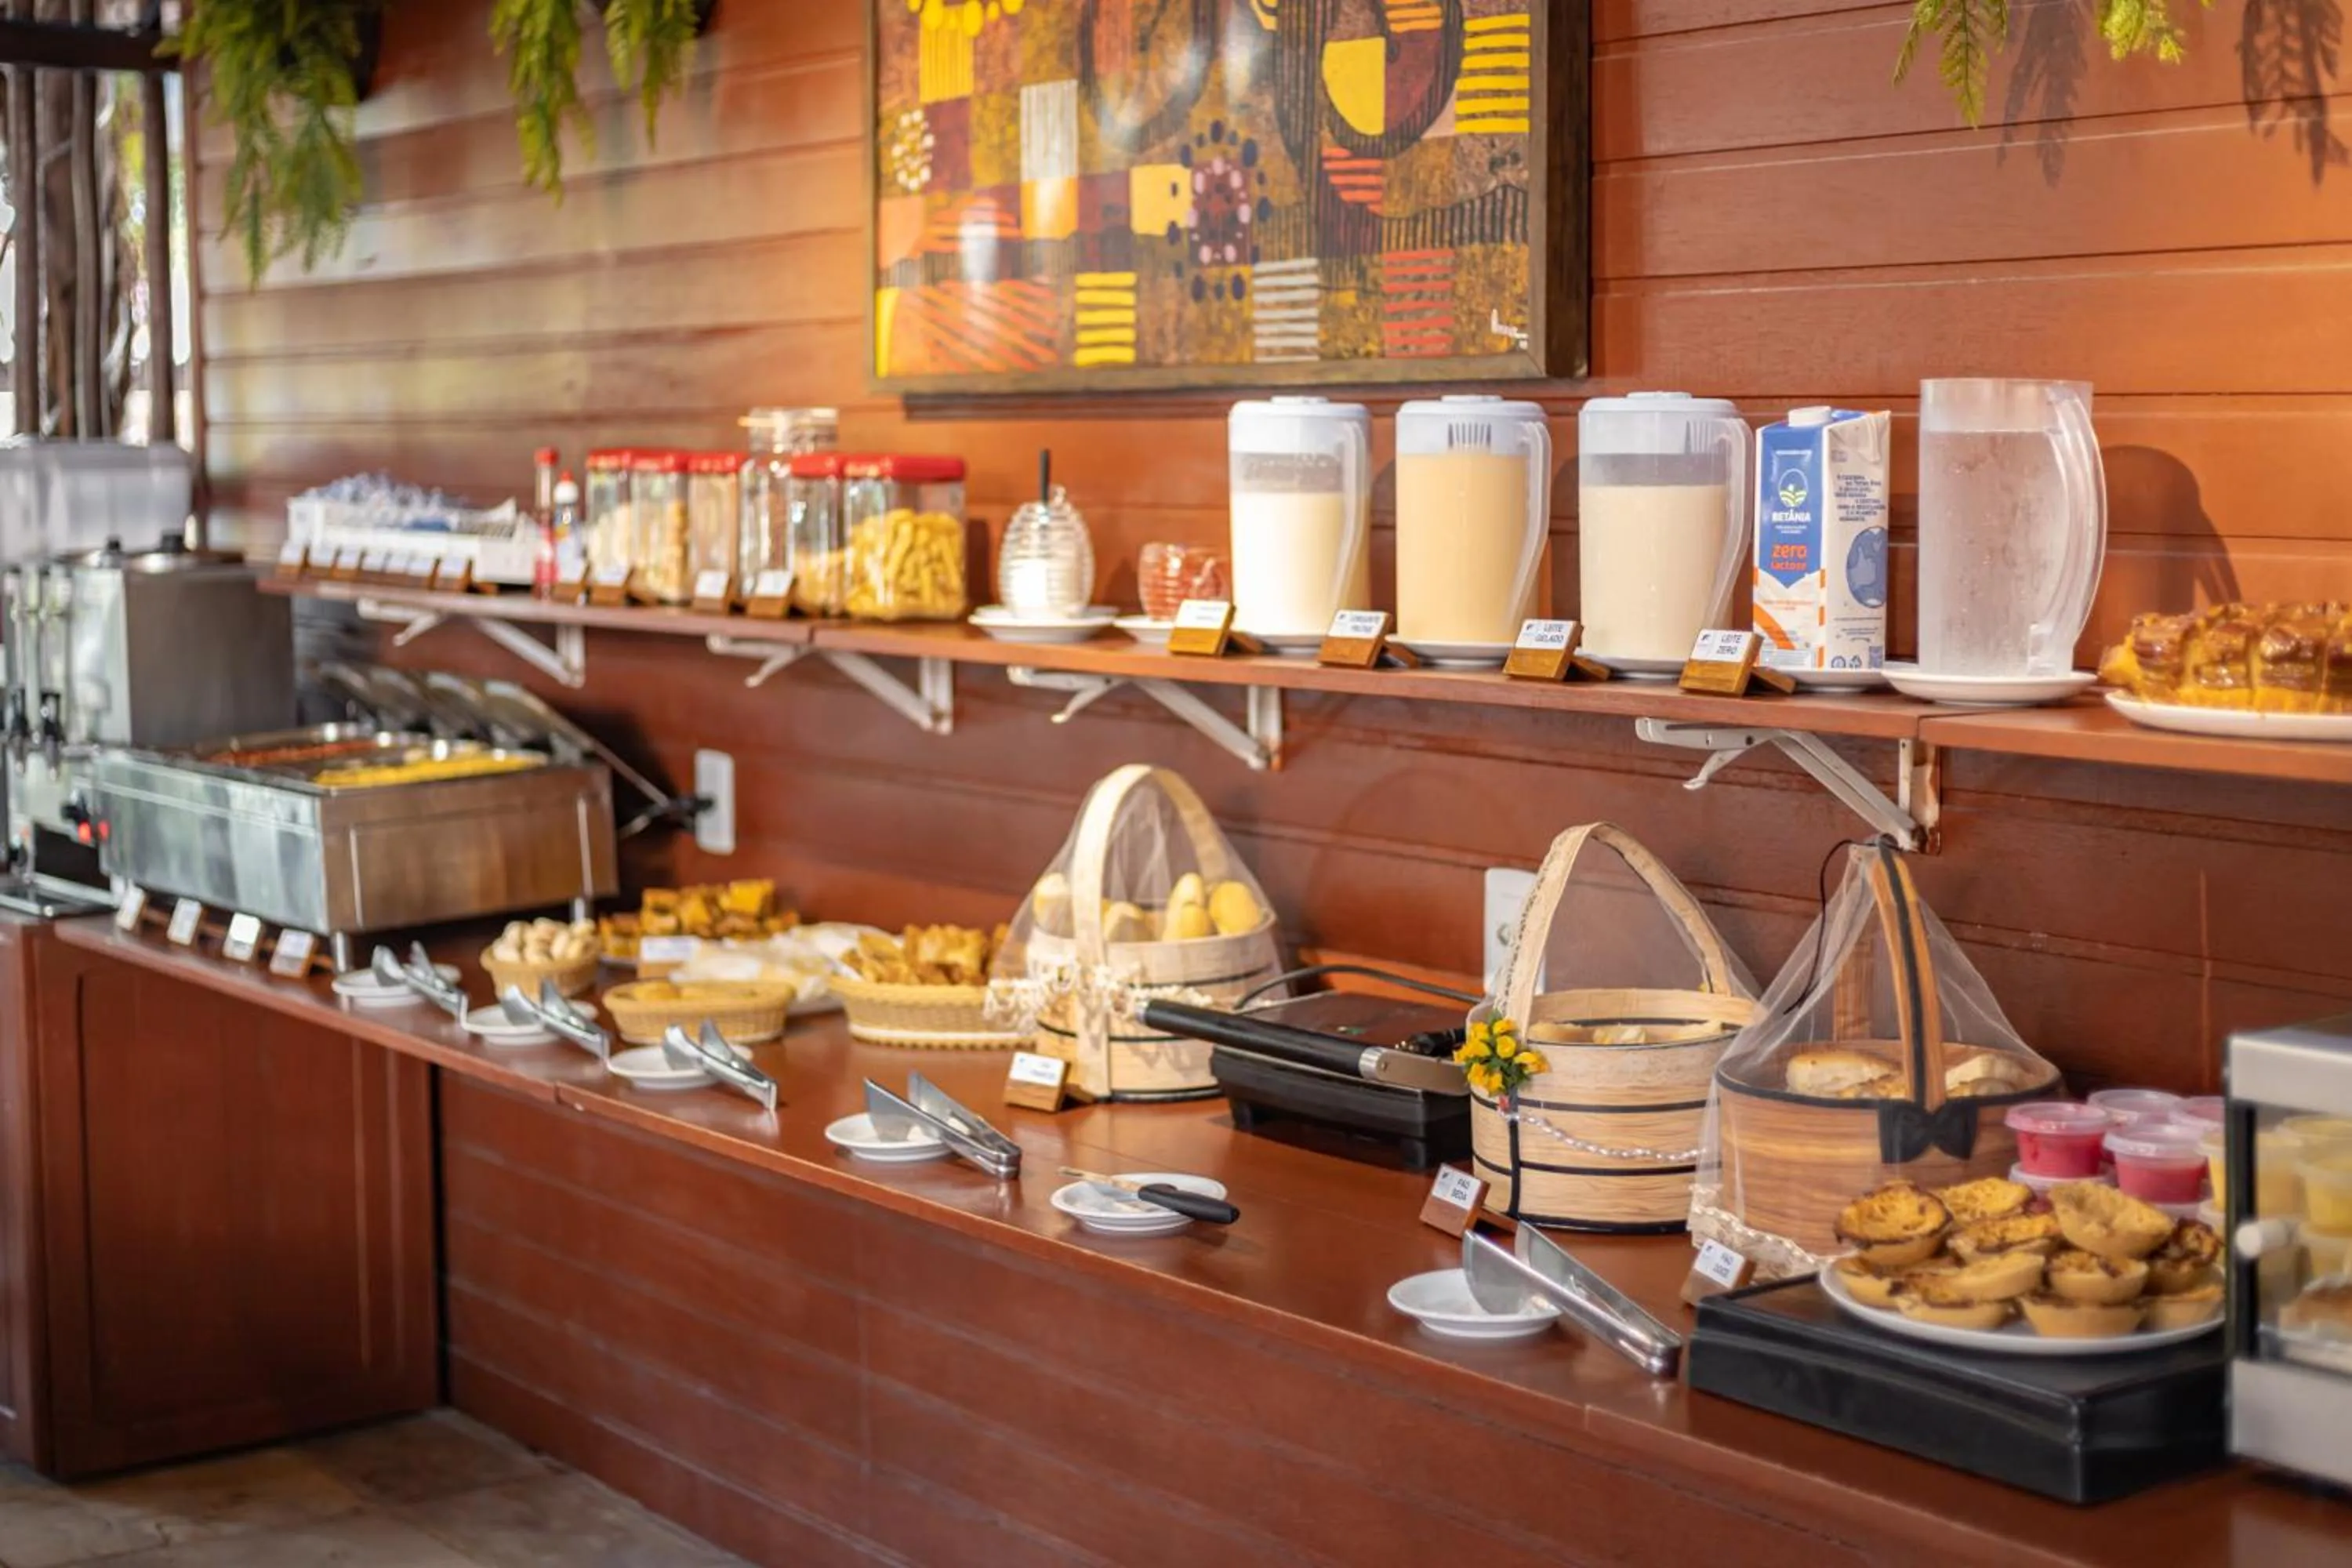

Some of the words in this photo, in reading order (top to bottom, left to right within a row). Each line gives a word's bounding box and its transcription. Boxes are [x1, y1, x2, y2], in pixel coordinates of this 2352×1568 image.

[1771, 509, 1811, 523] BETÂNIA
[1773, 544, 1806, 558] zero
[1543, 623, 1564, 633] LEITE
[1721, 633, 1743, 644] LEITE
[1716, 645, 1738, 655] ZERO
